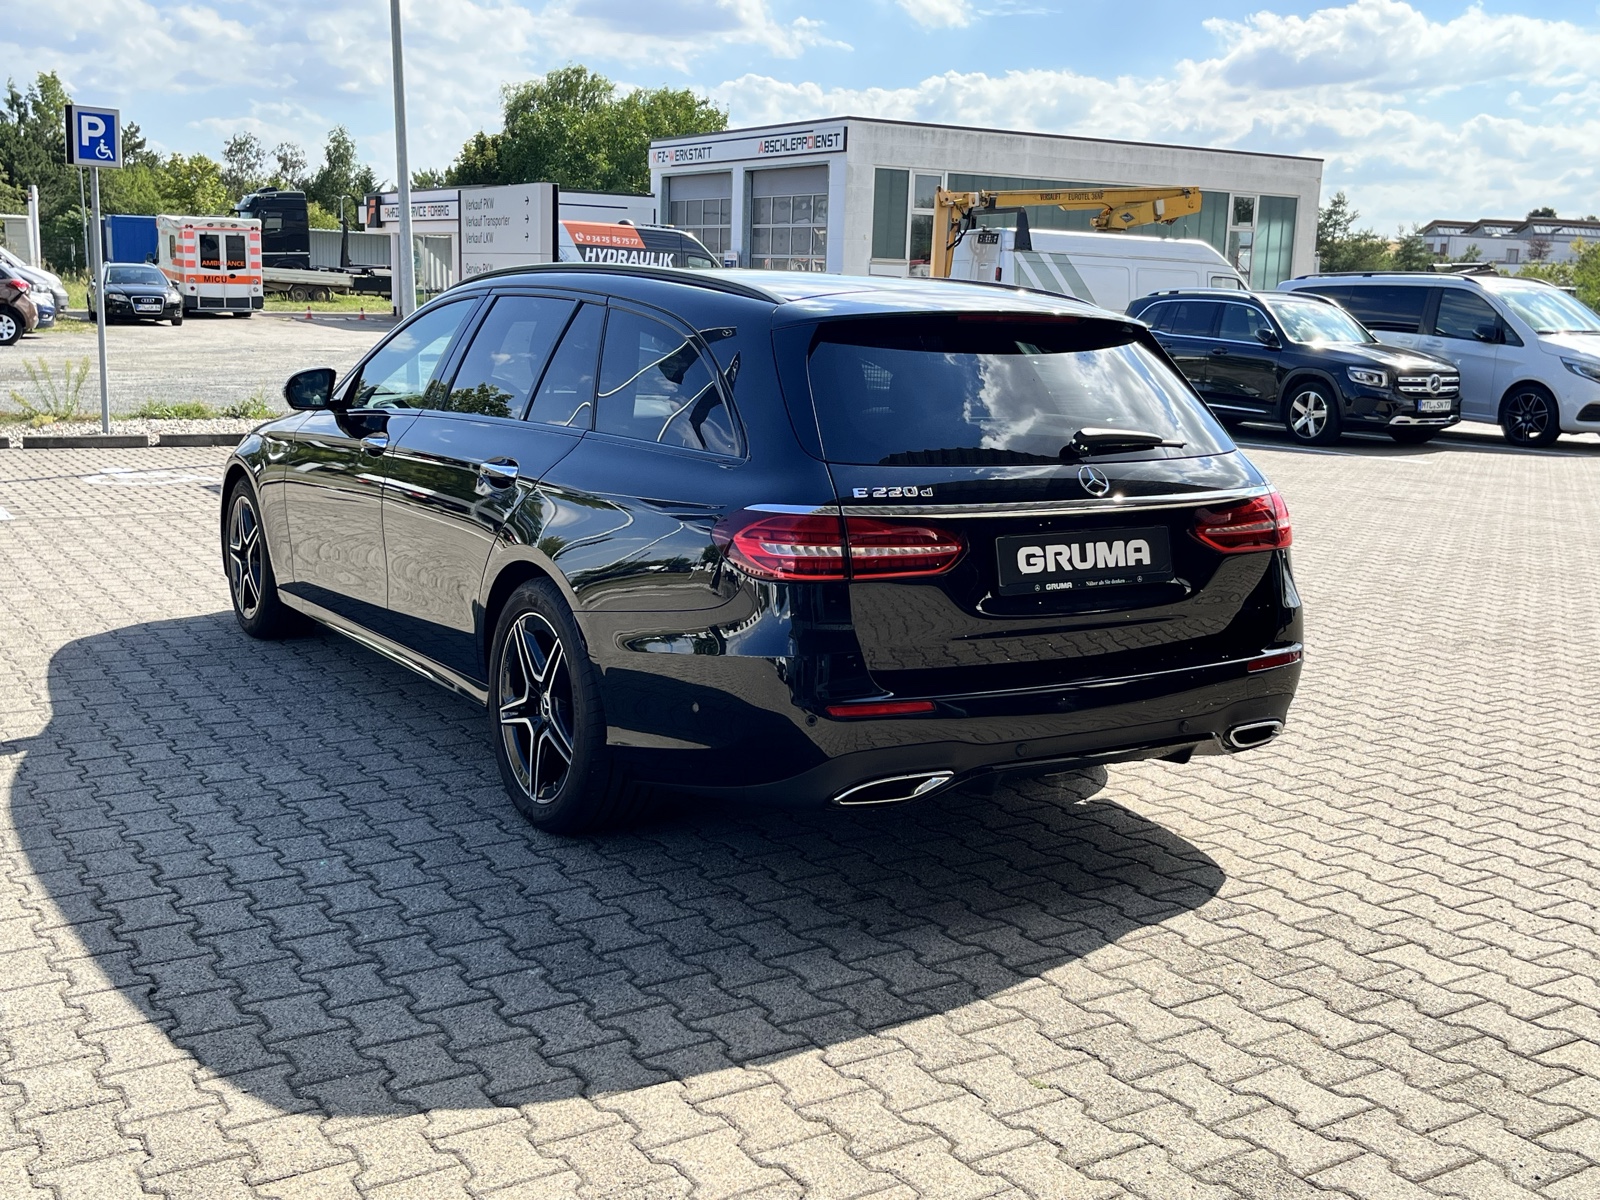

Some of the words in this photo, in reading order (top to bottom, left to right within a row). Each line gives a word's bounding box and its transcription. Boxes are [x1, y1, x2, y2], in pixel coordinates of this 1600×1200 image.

[81, 115, 106, 146] P
[652, 146, 712, 164] KFZ-WERKSTATT
[758, 133, 841, 154] ABSCHLEPPDIENST
[465, 198, 482, 210] Verkauf
[483, 197, 494, 209] PKW
[427, 205, 449, 217] FORBRIG
[465, 216, 482, 227] Verkauf
[483, 215, 510, 229] Transporter
[465, 232, 482, 244] Verkauf
[483, 232, 494, 244] LKW
[592, 235, 601, 243] 34
[612, 235, 621, 244] 85
[622, 237, 629, 245] 75
[630, 237, 639, 246] 77
[584, 247, 675, 268] HYDRAULIK
[465, 262, 482, 274] Service
[203, 275, 227, 283] MICU
[852, 487, 869, 499] E
[1016, 538, 1152, 576] GRUMA
[1045, 581, 1073, 591] GRUMA
